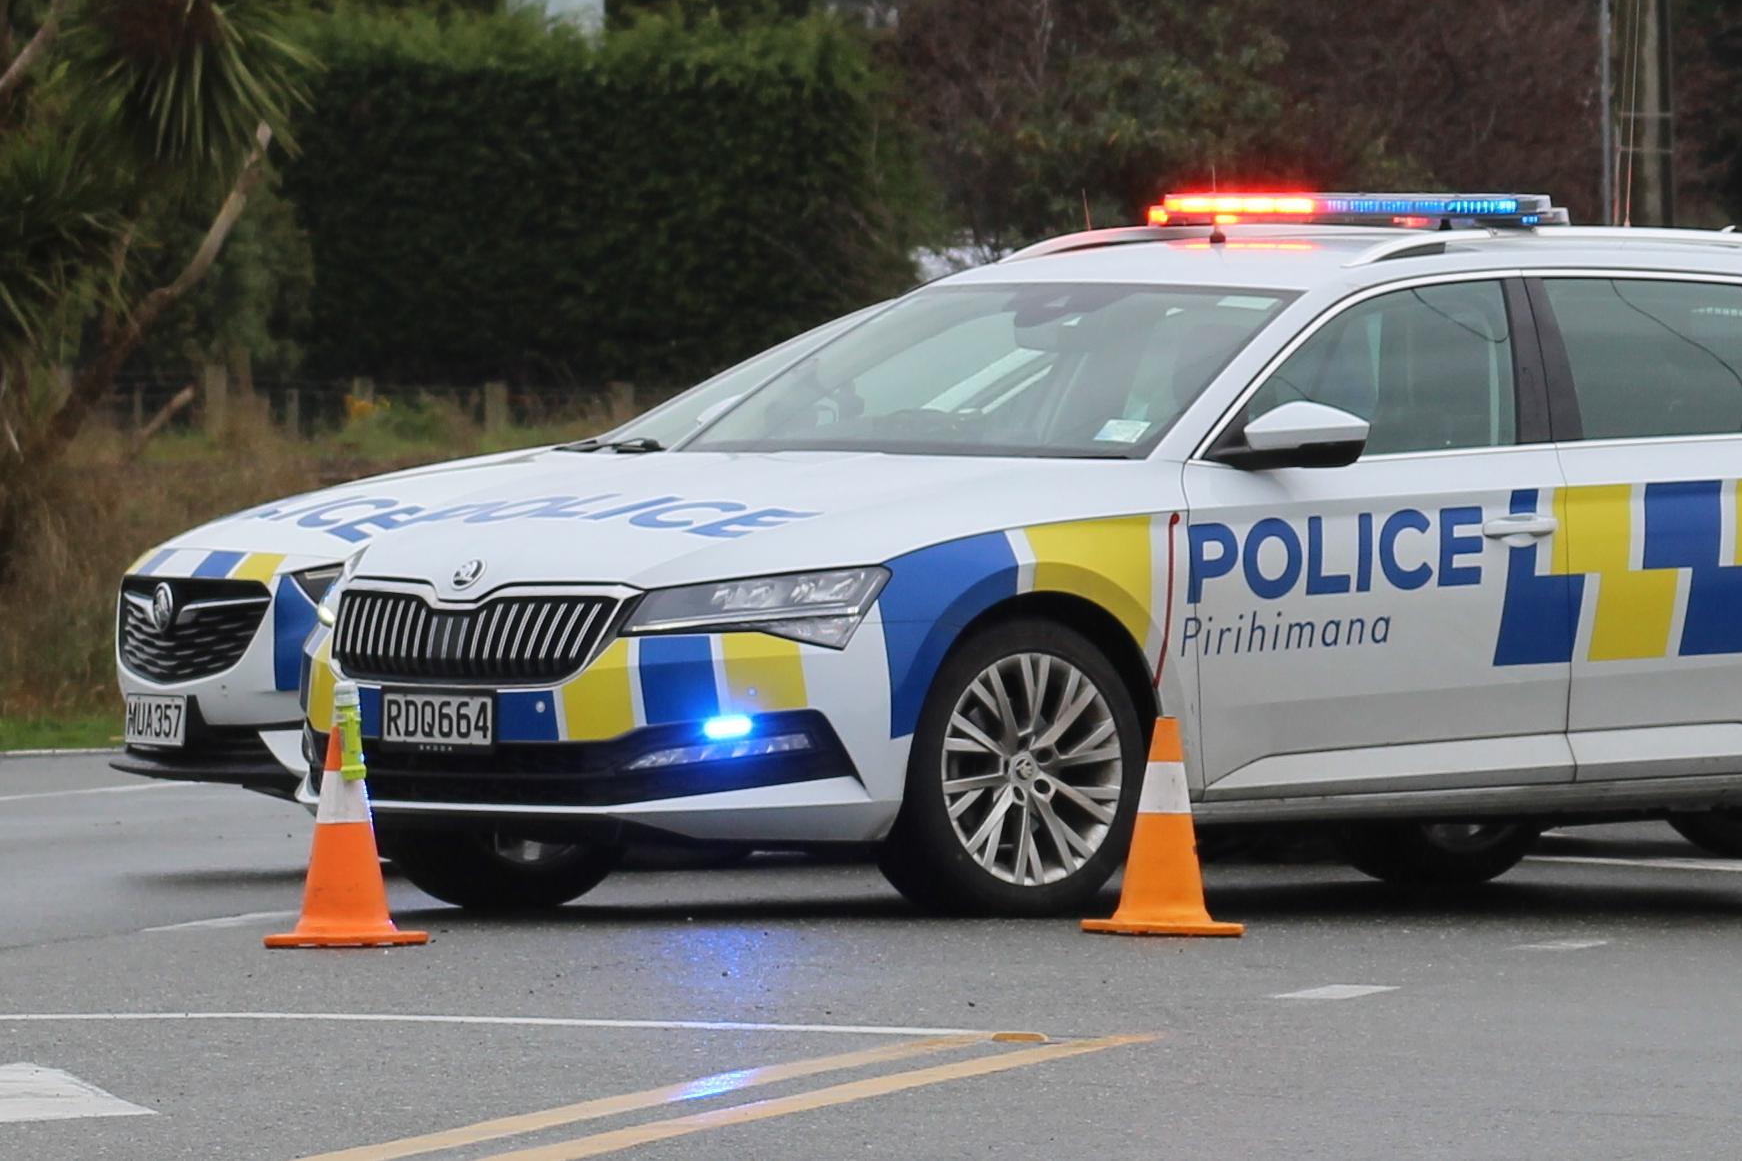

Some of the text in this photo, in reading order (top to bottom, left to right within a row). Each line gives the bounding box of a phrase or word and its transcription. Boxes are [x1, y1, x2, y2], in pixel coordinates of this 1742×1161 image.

[392, 493, 825, 539] POLICE
[1186, 506, 1484, 605] POLICE
[1180, 610, 1392, 658] Pirihimana
[386, 699, 490, 740] RDQ664
